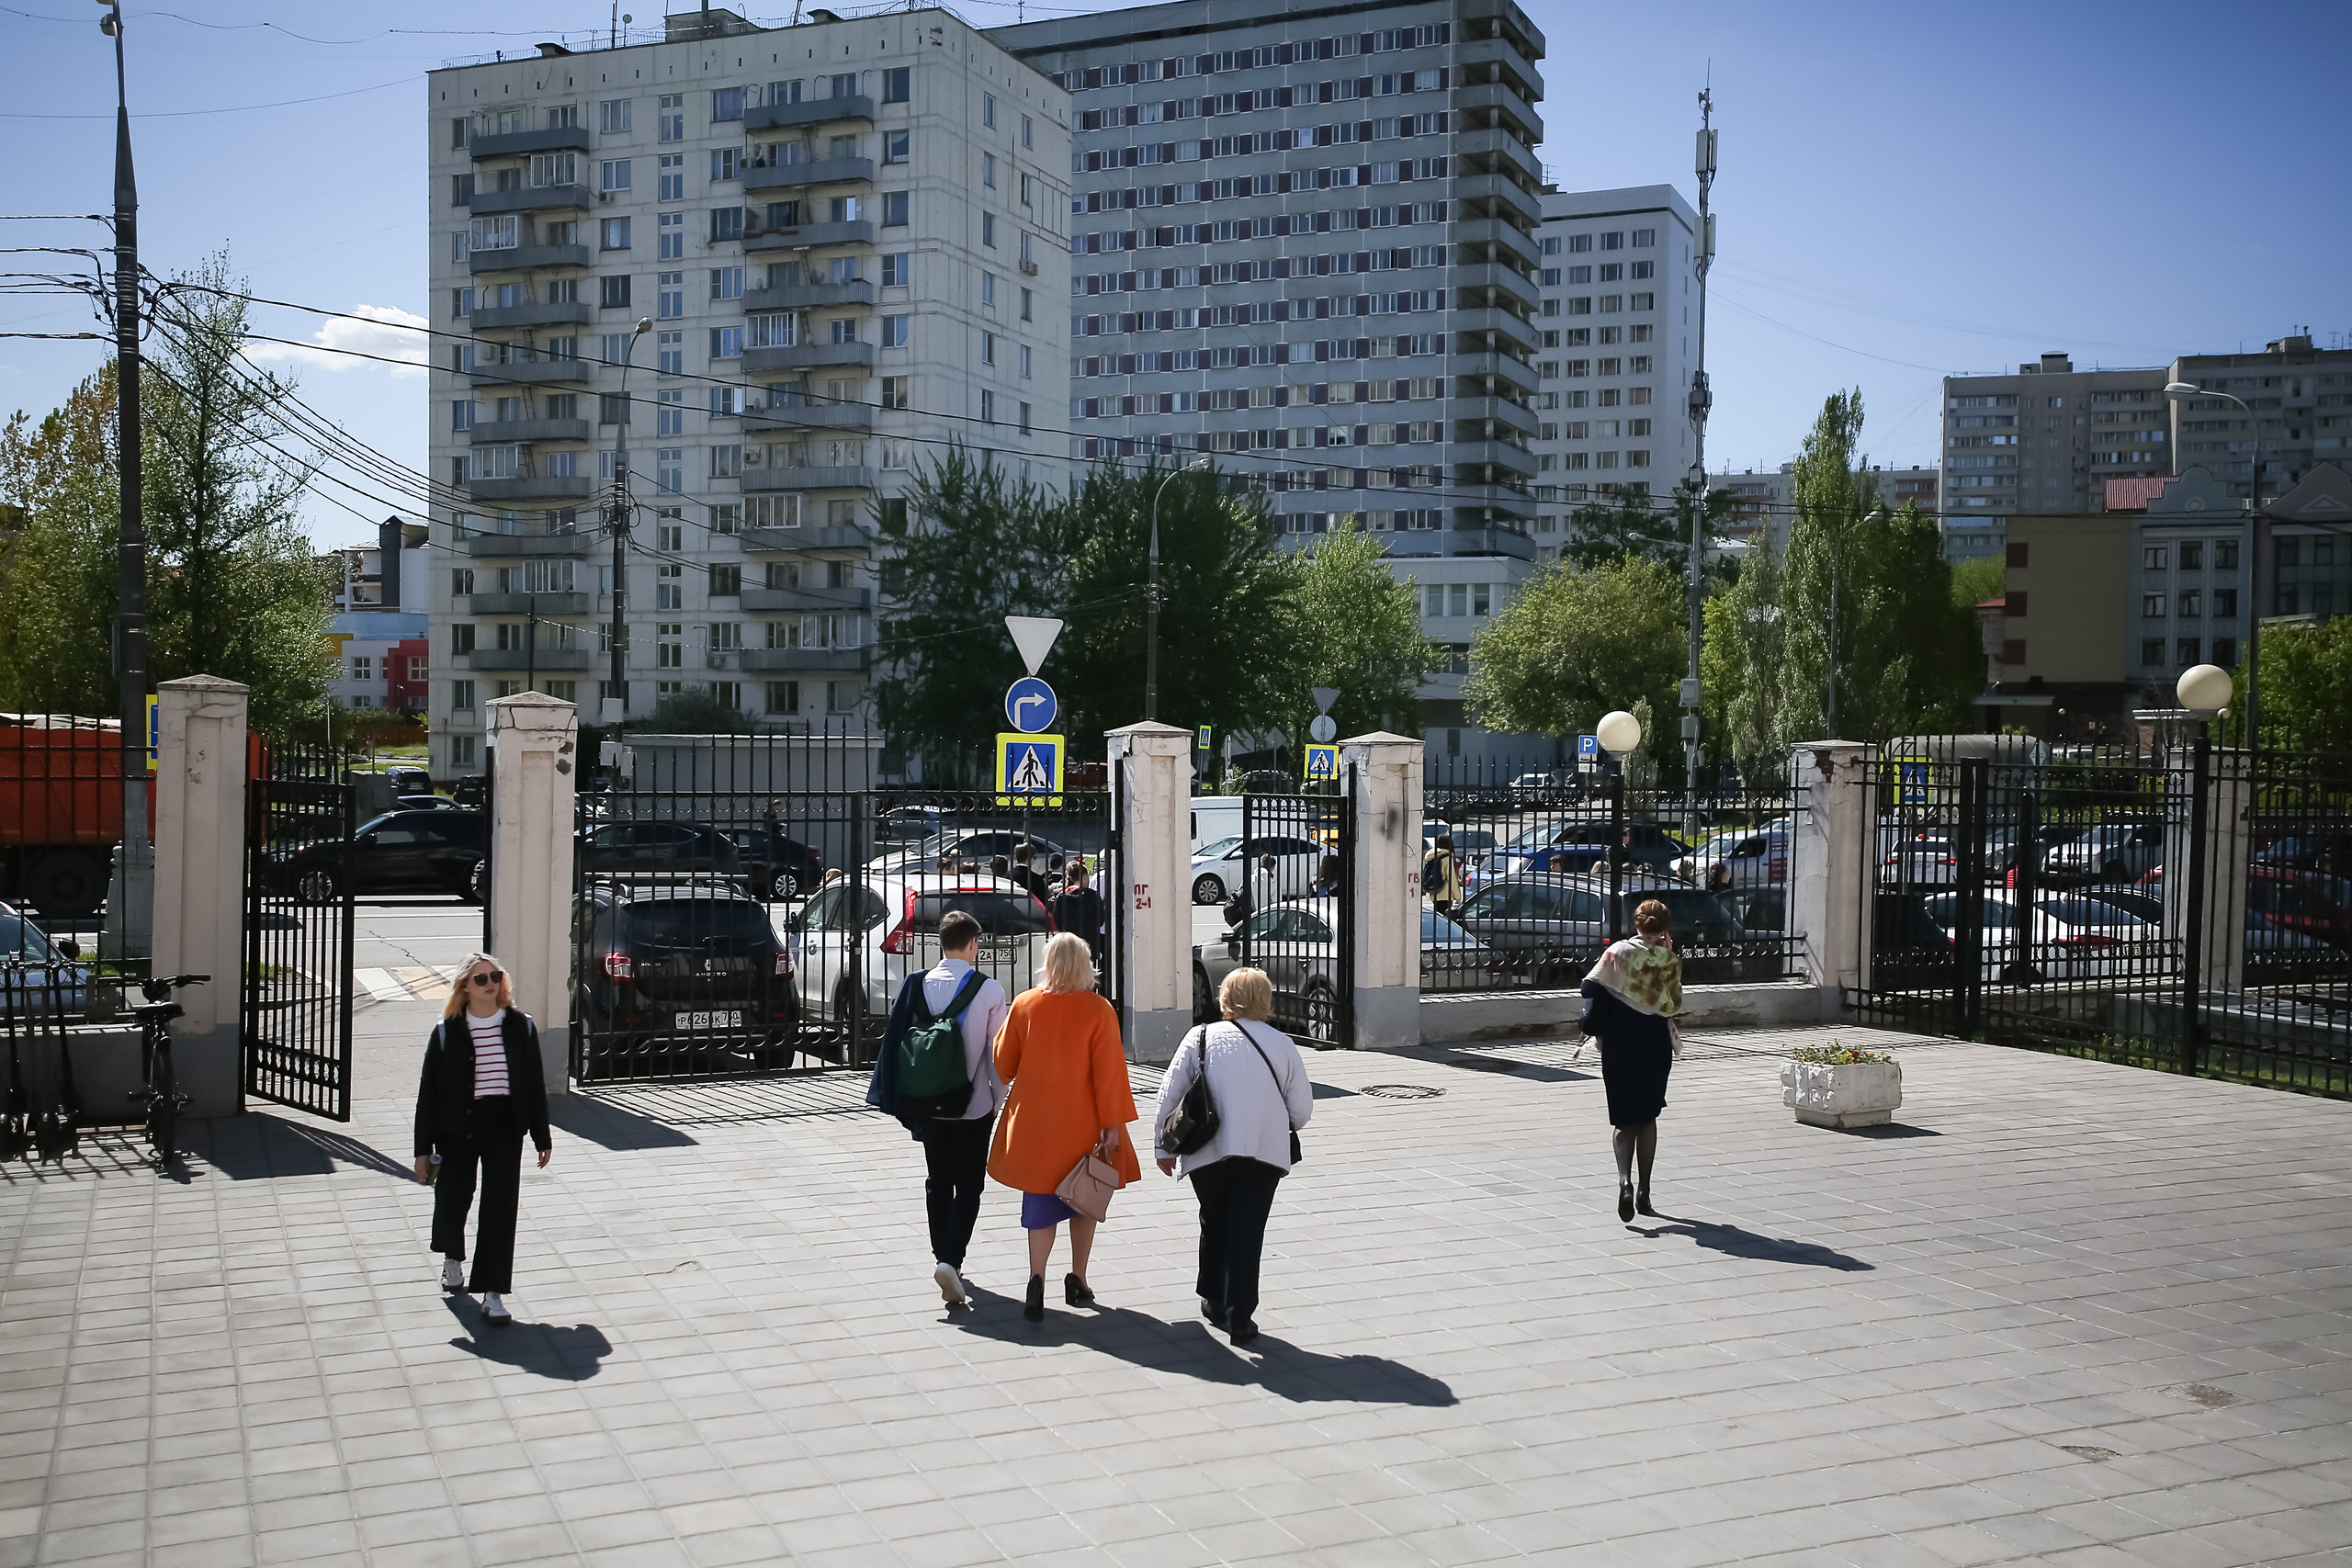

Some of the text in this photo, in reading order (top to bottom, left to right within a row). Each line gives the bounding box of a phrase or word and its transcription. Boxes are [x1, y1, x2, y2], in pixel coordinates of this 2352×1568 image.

[1583, 738, 1594, 751] P
[1134, 884, 1148, 896] ПГ
[1409, 887, 1415, 897] 1
